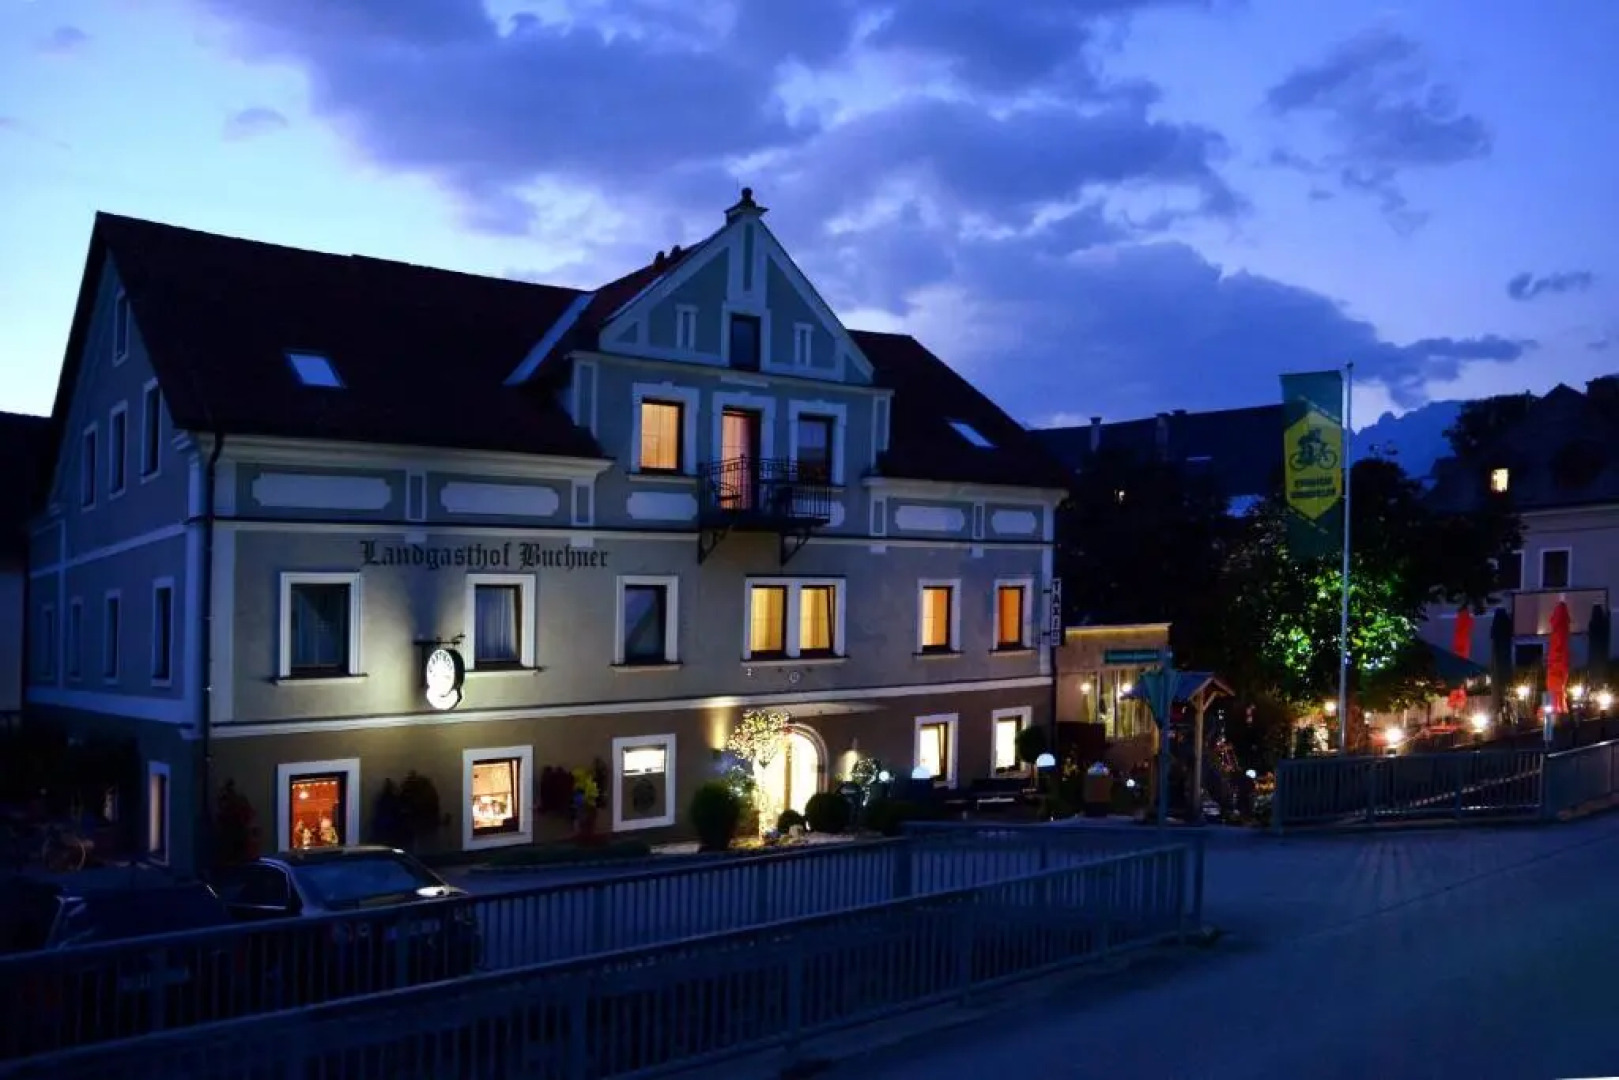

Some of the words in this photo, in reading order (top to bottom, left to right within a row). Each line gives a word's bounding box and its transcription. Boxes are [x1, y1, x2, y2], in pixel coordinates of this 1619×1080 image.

[360, 540, 512, 570] Landgasthof
[519, 542, 609, 570] Buchner
[1052, 580, 1061, 629] TAXI
